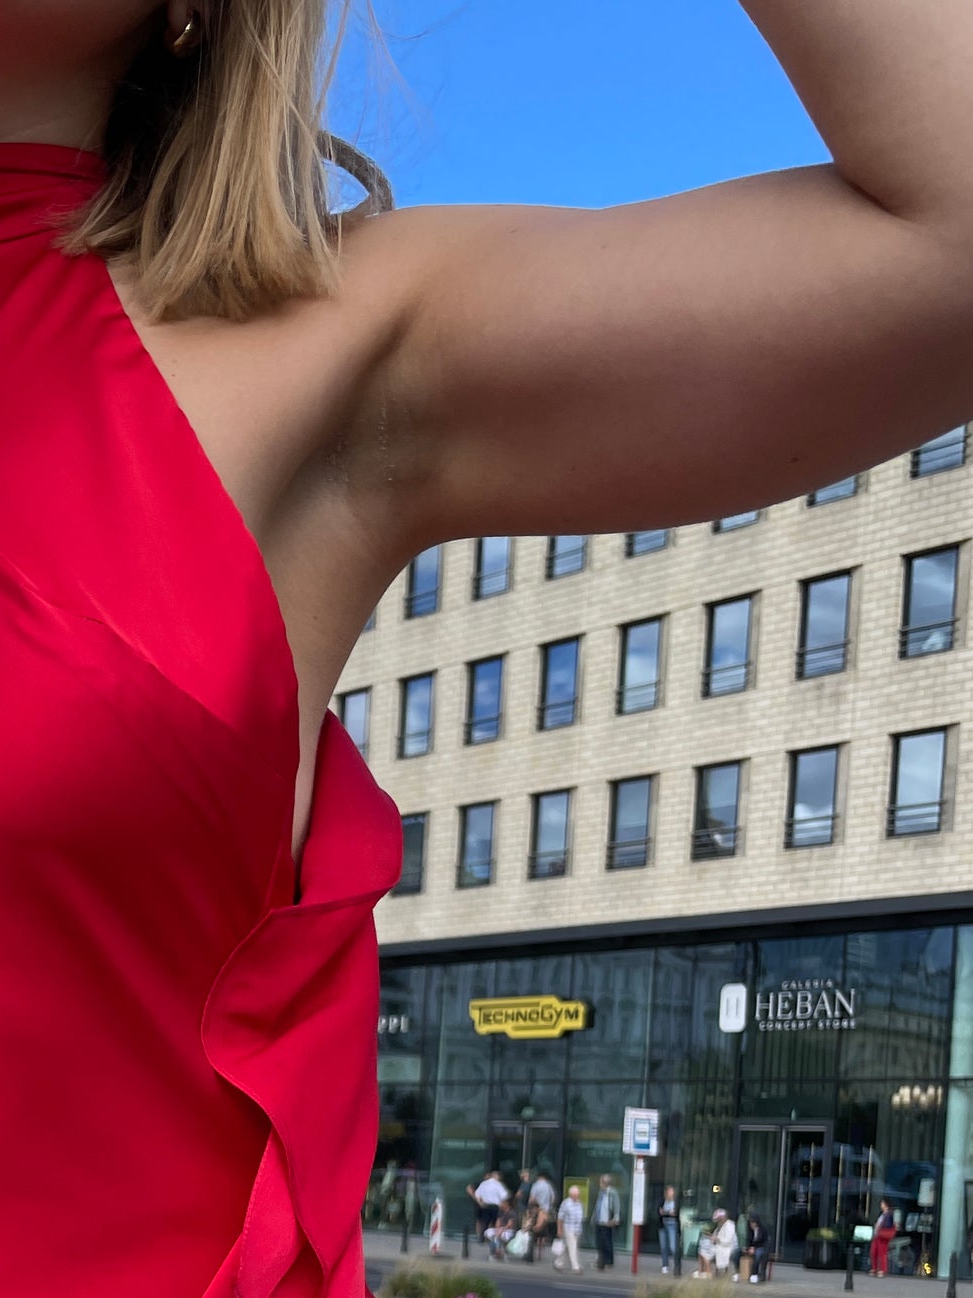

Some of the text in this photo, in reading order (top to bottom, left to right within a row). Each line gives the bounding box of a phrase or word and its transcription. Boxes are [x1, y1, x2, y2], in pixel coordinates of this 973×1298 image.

[781, 979, 833, 989] GALERIA
[755, 988, 856, 1020] HEBAN
[471, 1001, 579, 1030] TECHNOGYM
[759, 1019, 856, 1031] CONCEPT STORE
